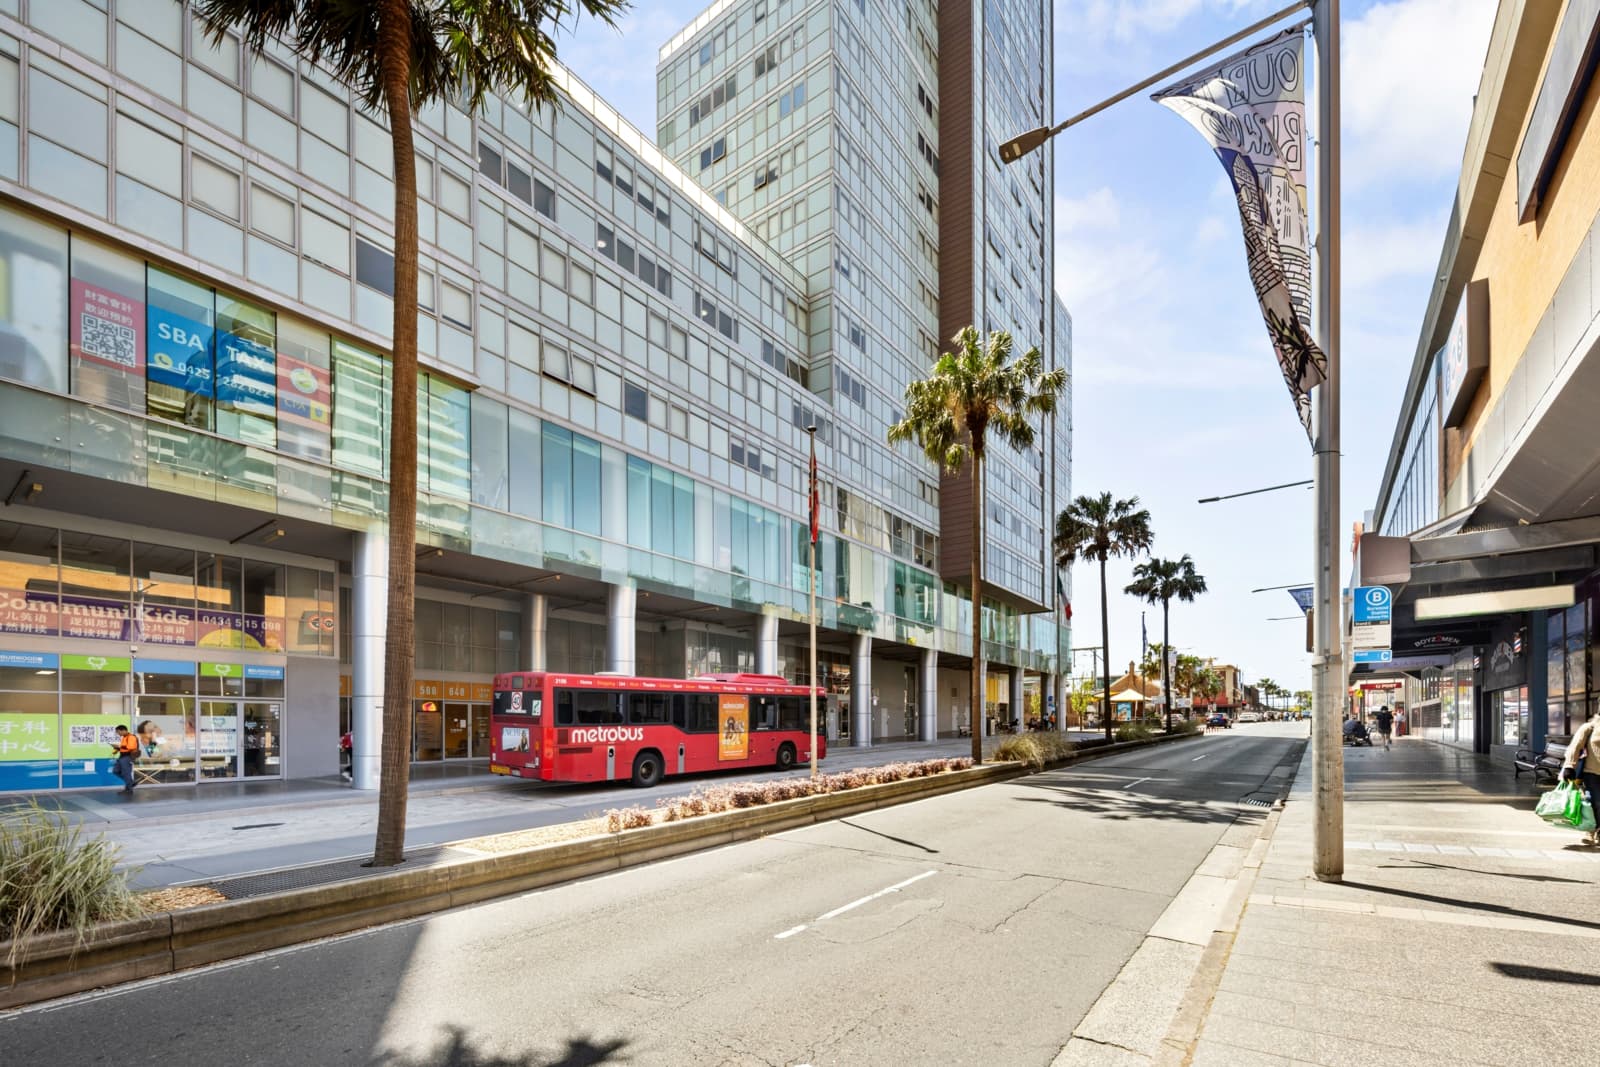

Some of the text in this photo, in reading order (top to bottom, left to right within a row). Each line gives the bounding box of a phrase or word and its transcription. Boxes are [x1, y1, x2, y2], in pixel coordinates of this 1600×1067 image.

[158, 322, 205, 352] SBA
[178, 362, 210, 380] 0425
[1372, 591, 1382, 602] B
[0, 610, 47, 623] 儿英语
[202, 615, 231, 627] 0434
[235, 618, 257, 629] 515
[0, 622, 47, 634] 然拼读
[1381, 652, 1389, 661] C
[571, 726, 644, 743] metrobus
